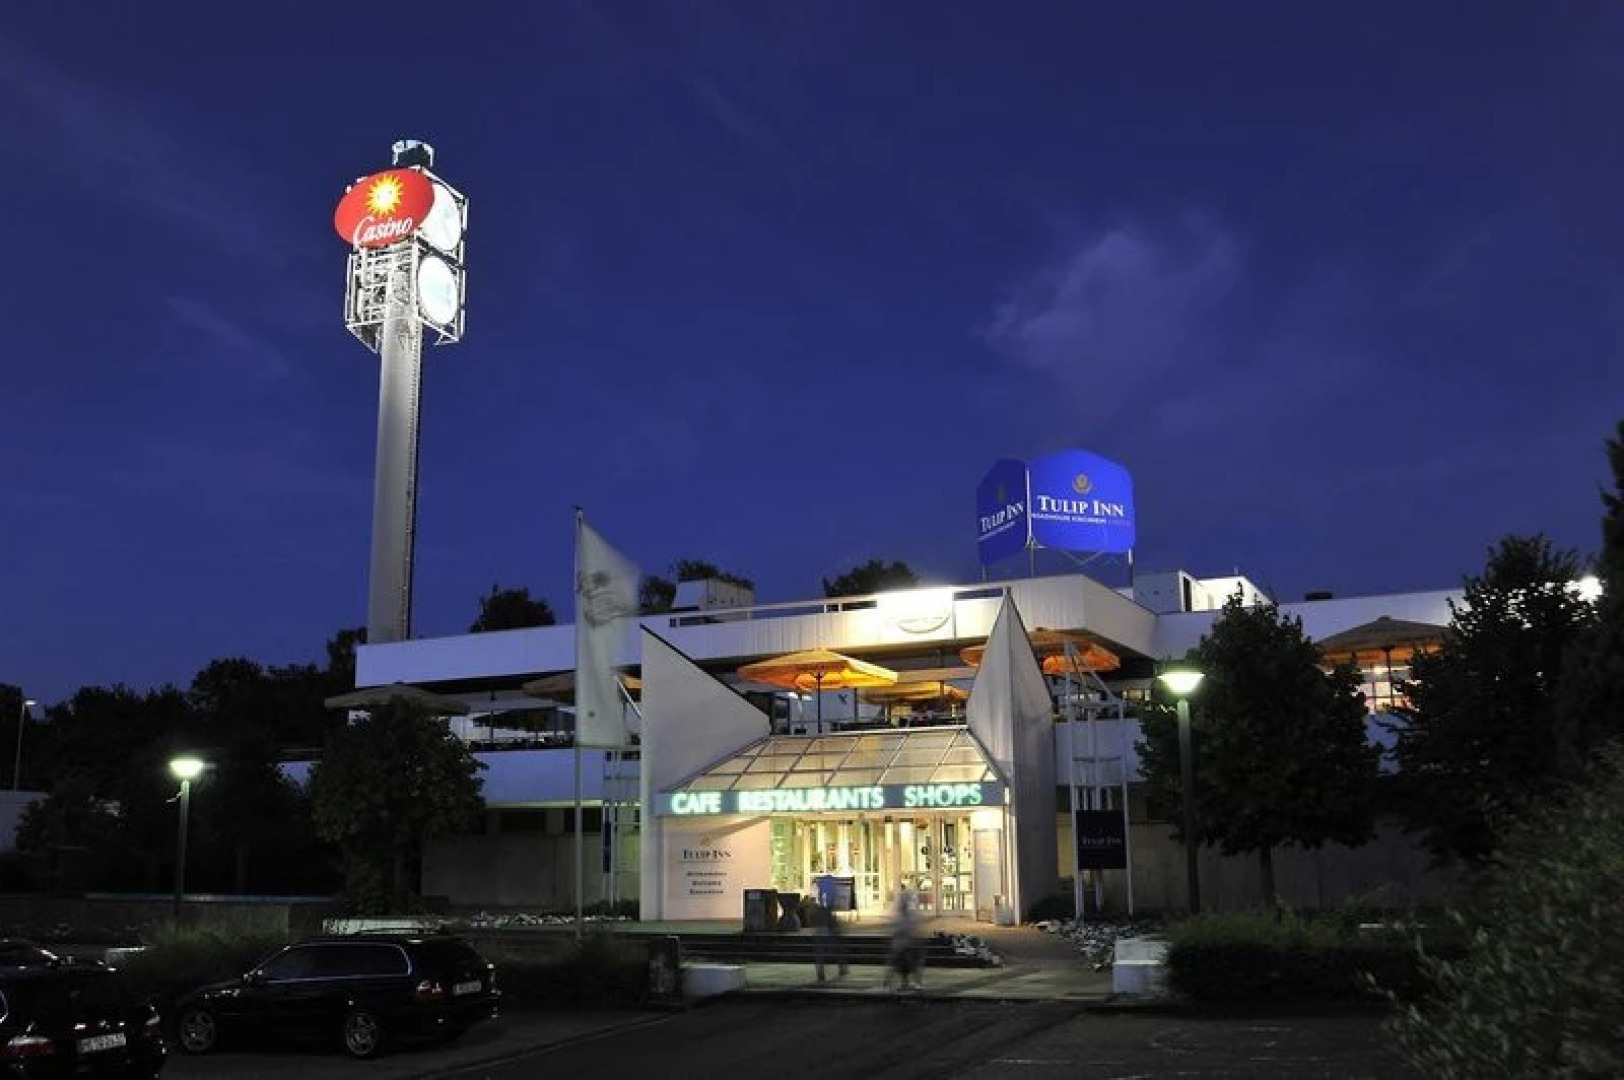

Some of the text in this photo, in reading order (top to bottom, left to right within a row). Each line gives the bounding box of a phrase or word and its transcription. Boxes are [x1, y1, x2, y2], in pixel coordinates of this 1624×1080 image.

[353, 216, 413, 244] Casino
[1037, 495, 1124, 517] TULIP INN
[672, 784, 982, 814] CAFE RESTAURANTS SHOPS
